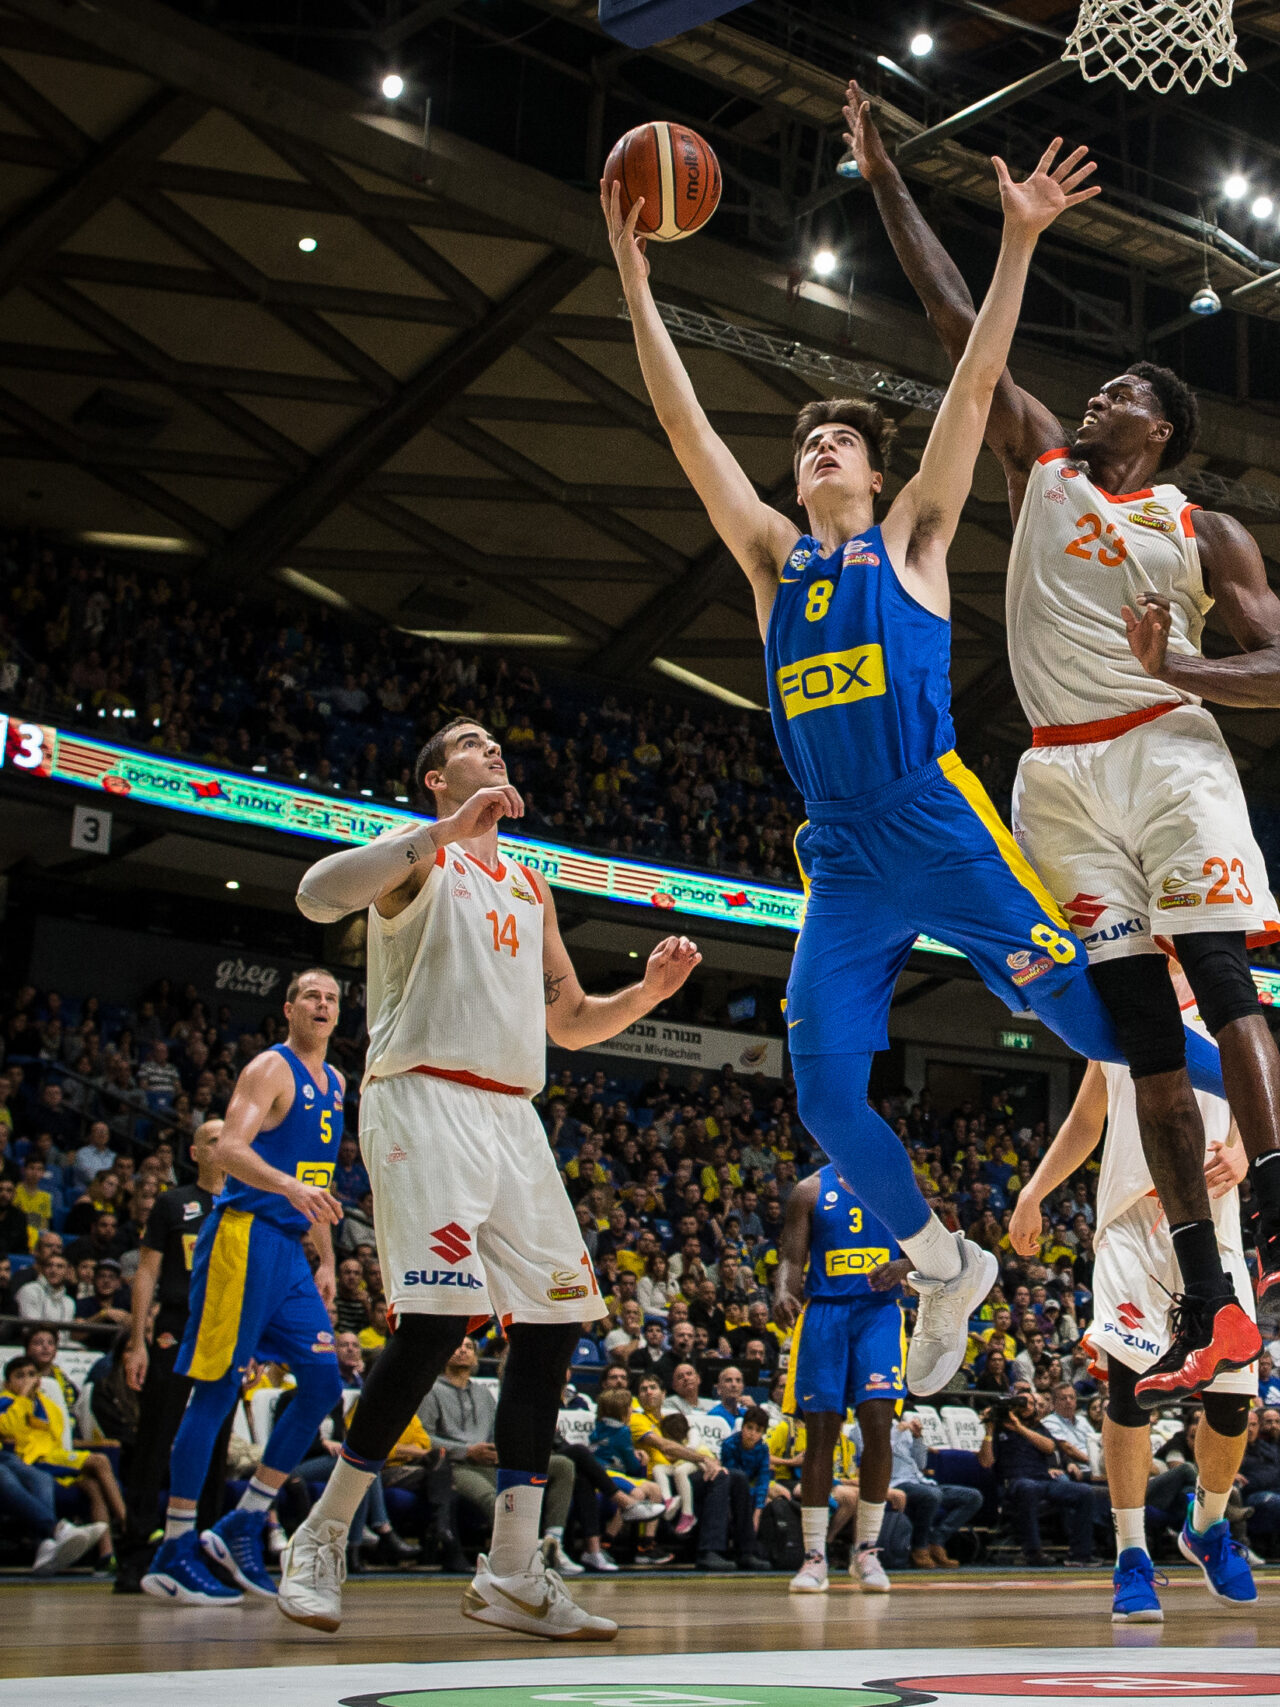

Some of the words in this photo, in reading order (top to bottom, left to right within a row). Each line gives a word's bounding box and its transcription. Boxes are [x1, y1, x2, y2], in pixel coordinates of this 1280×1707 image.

[680, 134, 699, 200] molten
[1064, 513, 1128, 567] 23
[805, 579, 834, 622] 8
[127, 769, 181, 791] ספרים
[235, 794, 282, 814] צומת
[82, 816, 100, 843] 3
[672, 884, 716, 902] ספרים
[1202, 856, 1253, 905] 23
[759, 901, 797, 917] צומת
[485, 909, 519, 958] 14
[1030, 923, 1076, 963] 8
[1083, 918, 1144, 943] ZUKI
[627, 1024, 656, 1038] מבט
[662, 1028, 702, 1044] מנורה
[320, 1110, 332, 1143] 5
[302, 1169, 331, 1188] FO
[848, 1207, 863, 1233] 3
[831, 1254, 883, 1271] FOX
[403, 1270, 484, 1290] SUZU
[1104, 1322, 1160, 1356] SUZUKI
